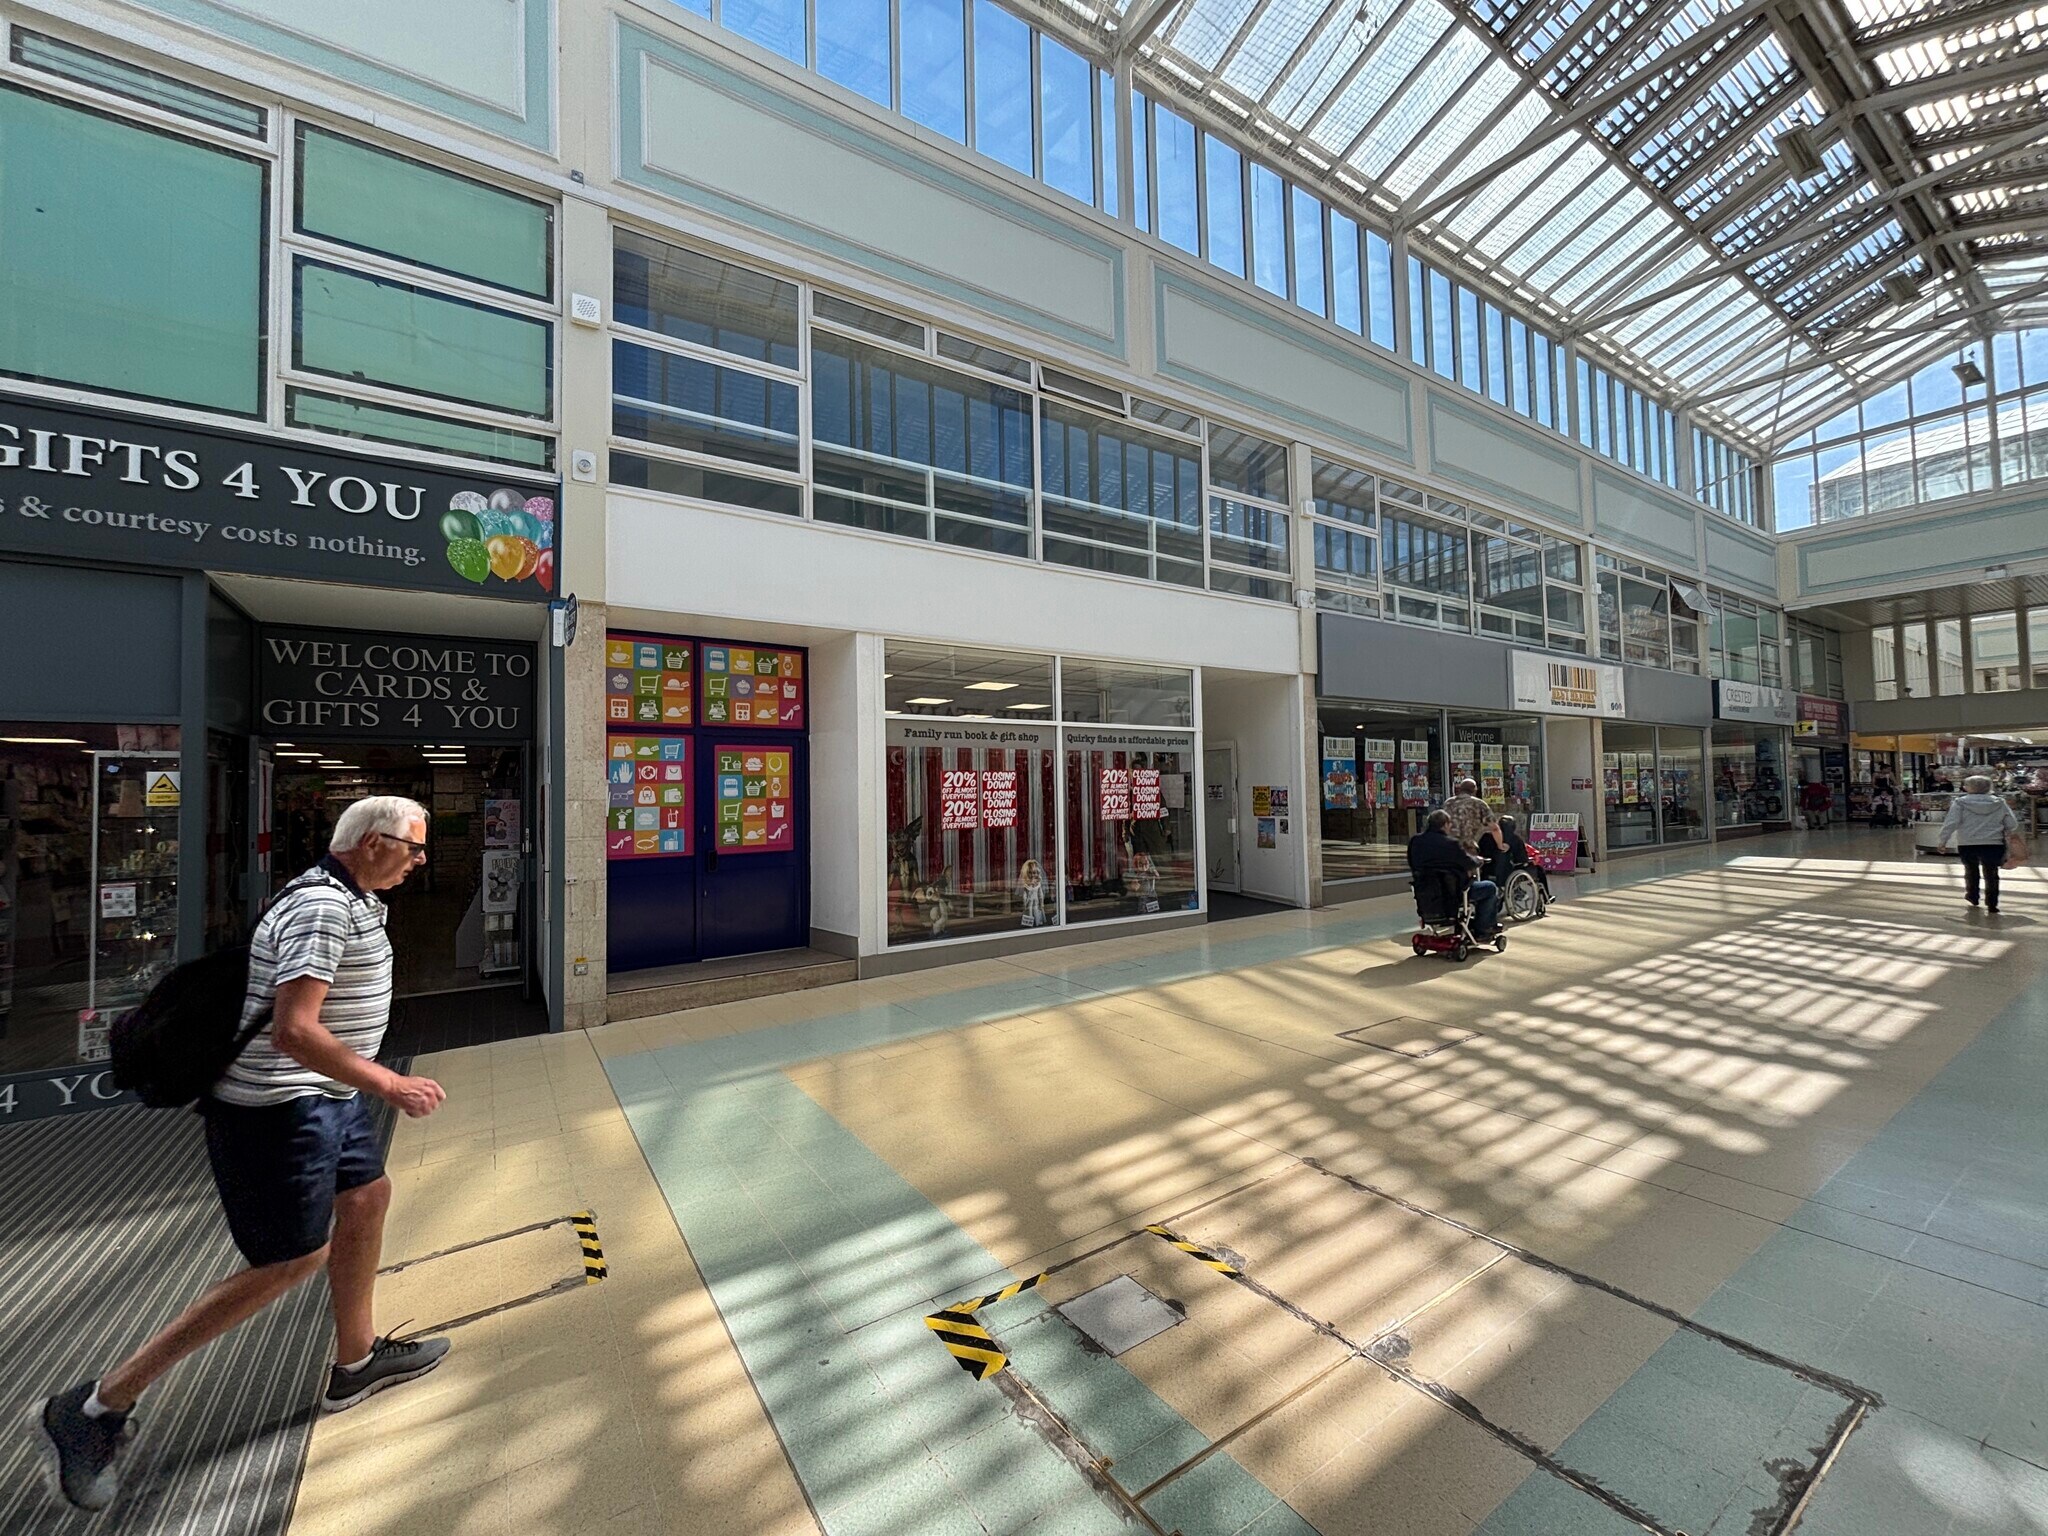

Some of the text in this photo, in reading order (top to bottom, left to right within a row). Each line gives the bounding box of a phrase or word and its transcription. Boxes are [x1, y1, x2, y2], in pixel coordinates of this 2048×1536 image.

[222, 462, 260, 499] 4
[279, 466, 427, 521] YOU
[19, 495, 52, 520] &
[63, 506, 212, 543] courtesy
[221, 525, 299, 548] costs
[308, 535, 427, 567] nothing.
[266, 638, 531, 677] WELCOME TO
[315, 671, 490, 701] CARDS &
[262, 699, 521, 729] GIFTS 4 YOU
[904, 728, 1039, 743] Family run book & gift shop
[1067, 733, 1189, 746] Quirky finds at affordable prices
[1458, 729, 1495, 743] Welcome
[943, 771, 976, 788] 20%
[982, 772, 1016, 781] CLOSING
[1102, 769, 1128, 783] 20%
[1132, 769, 1160, 778] CLOSING
[986, 780, 1013, 789] DOWN
[1136, 778, 1157, 786] DOWN
[983, 791, 1016, 800] CLOSING
[1132, 786, 1160, 795] CLOSING
[987, 799, 1013, 808] DOWN
[1102, 795, 1128, 809] 20%
[1136, 794, 1157, 802] DOWN
[943, 800, 977, 816] 20%
[1133, 802, 1160, 811] CLOSING
[983, 809, 1017, 818] CLOSING
[1136, 811, 1157, 819] DOWN
[987, 818, 1013, 827] DOWN
[0, 1084, 19, 1114] 4
